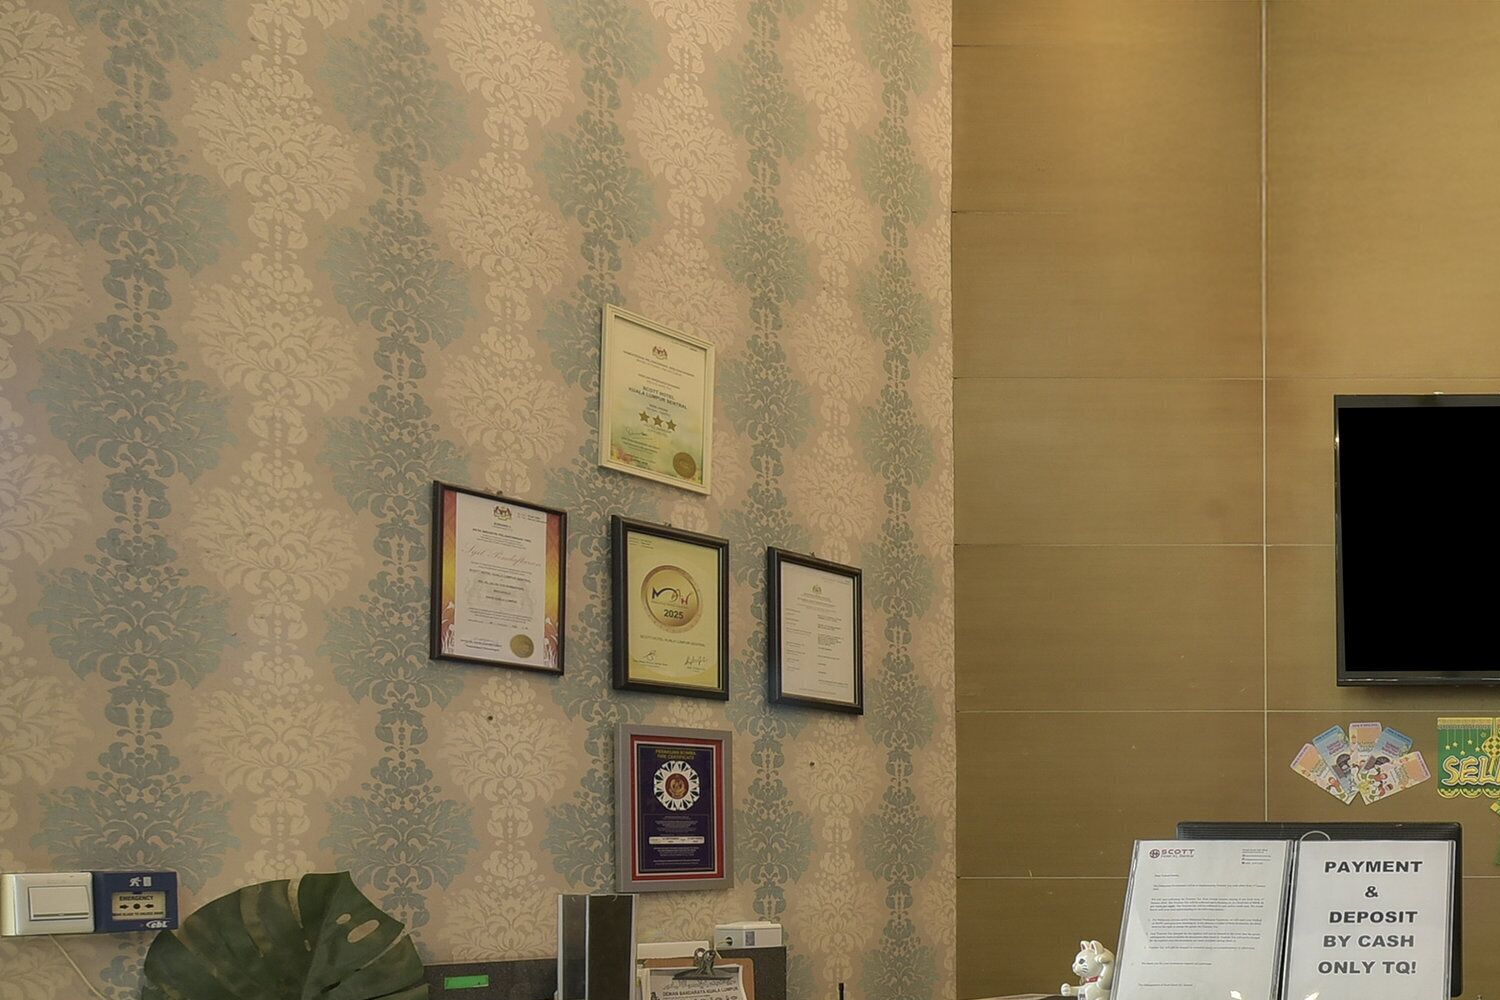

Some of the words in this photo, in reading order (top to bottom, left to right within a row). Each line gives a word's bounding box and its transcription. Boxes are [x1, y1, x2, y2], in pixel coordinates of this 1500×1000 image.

[664, 609, 683, 619] 2025
[1325, 861, 1422, 872] PAYMENT
[1365, 886, 1378, 897] &
[1329, 911, 1418, 923] DEPOSIT
[1324, 935, 1351, 947] BY
[1358, 935, 1414, 947] CASH
[1318, 962, 1375, 974] ONLY
[1382, 962, 1416, 974] TQ!
